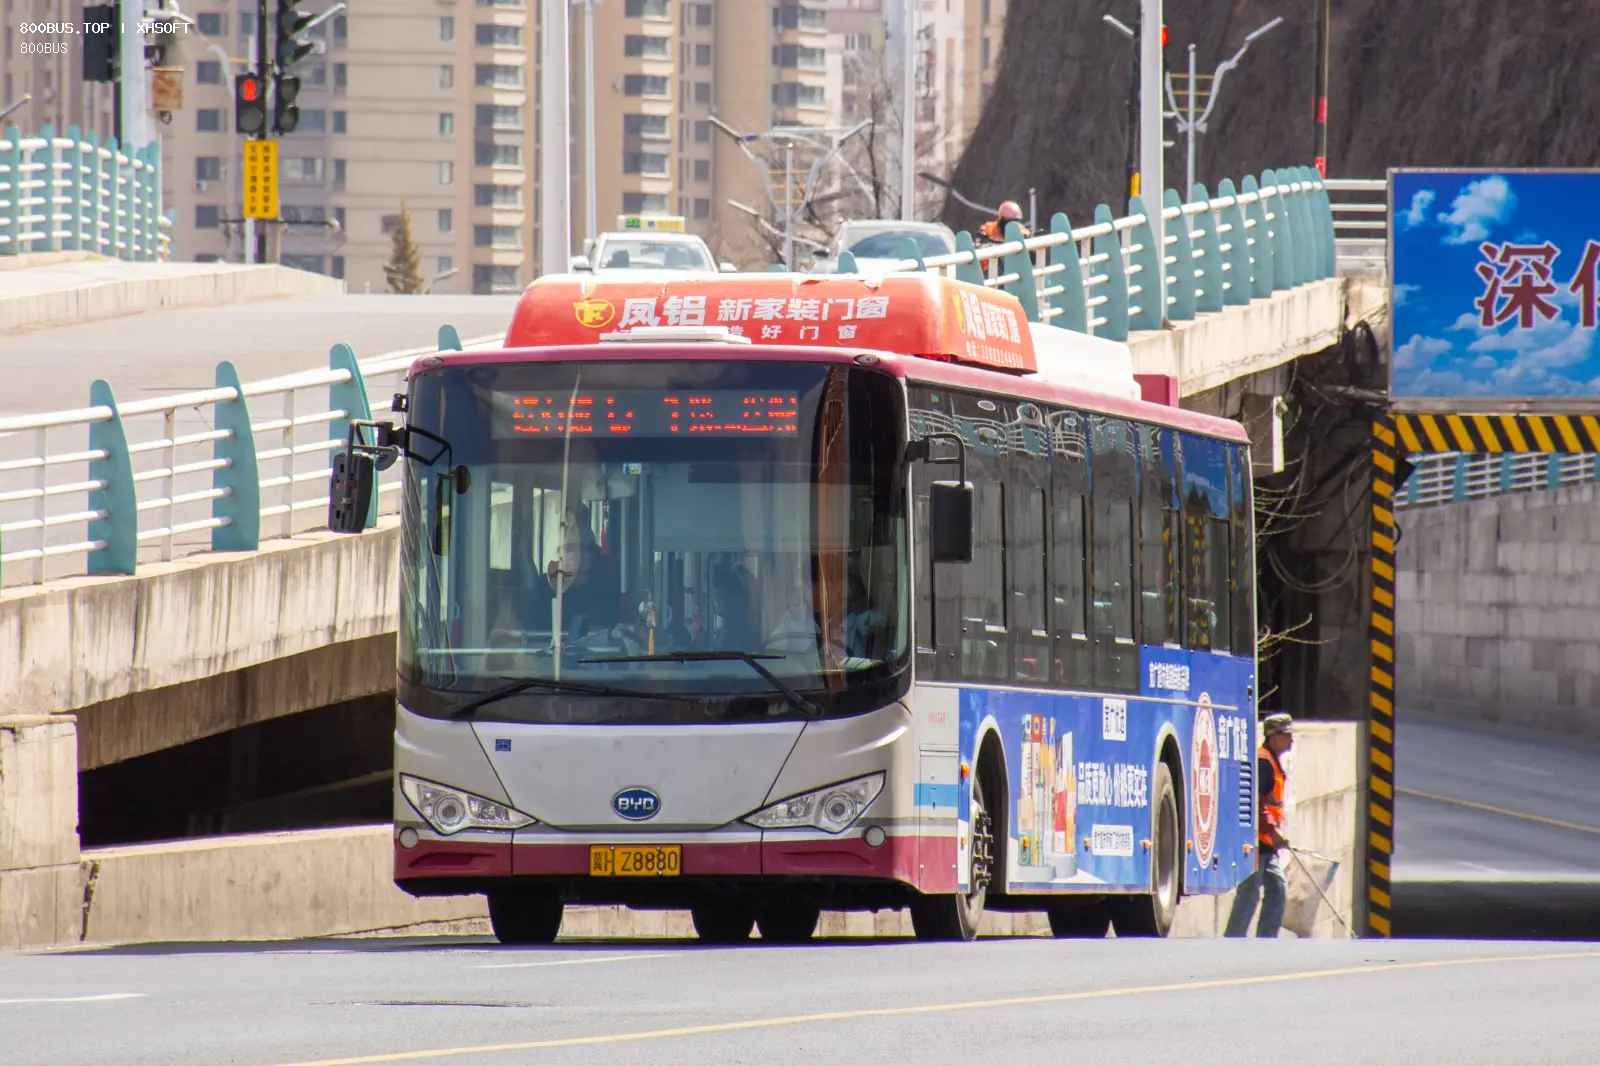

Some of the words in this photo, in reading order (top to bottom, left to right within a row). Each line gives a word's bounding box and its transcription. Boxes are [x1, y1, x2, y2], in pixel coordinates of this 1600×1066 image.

[618, 295, 707, 328] 凤铝
[716, 296, 889, 321] 新家装门窗
[618, 797, 654, 811] BYD
